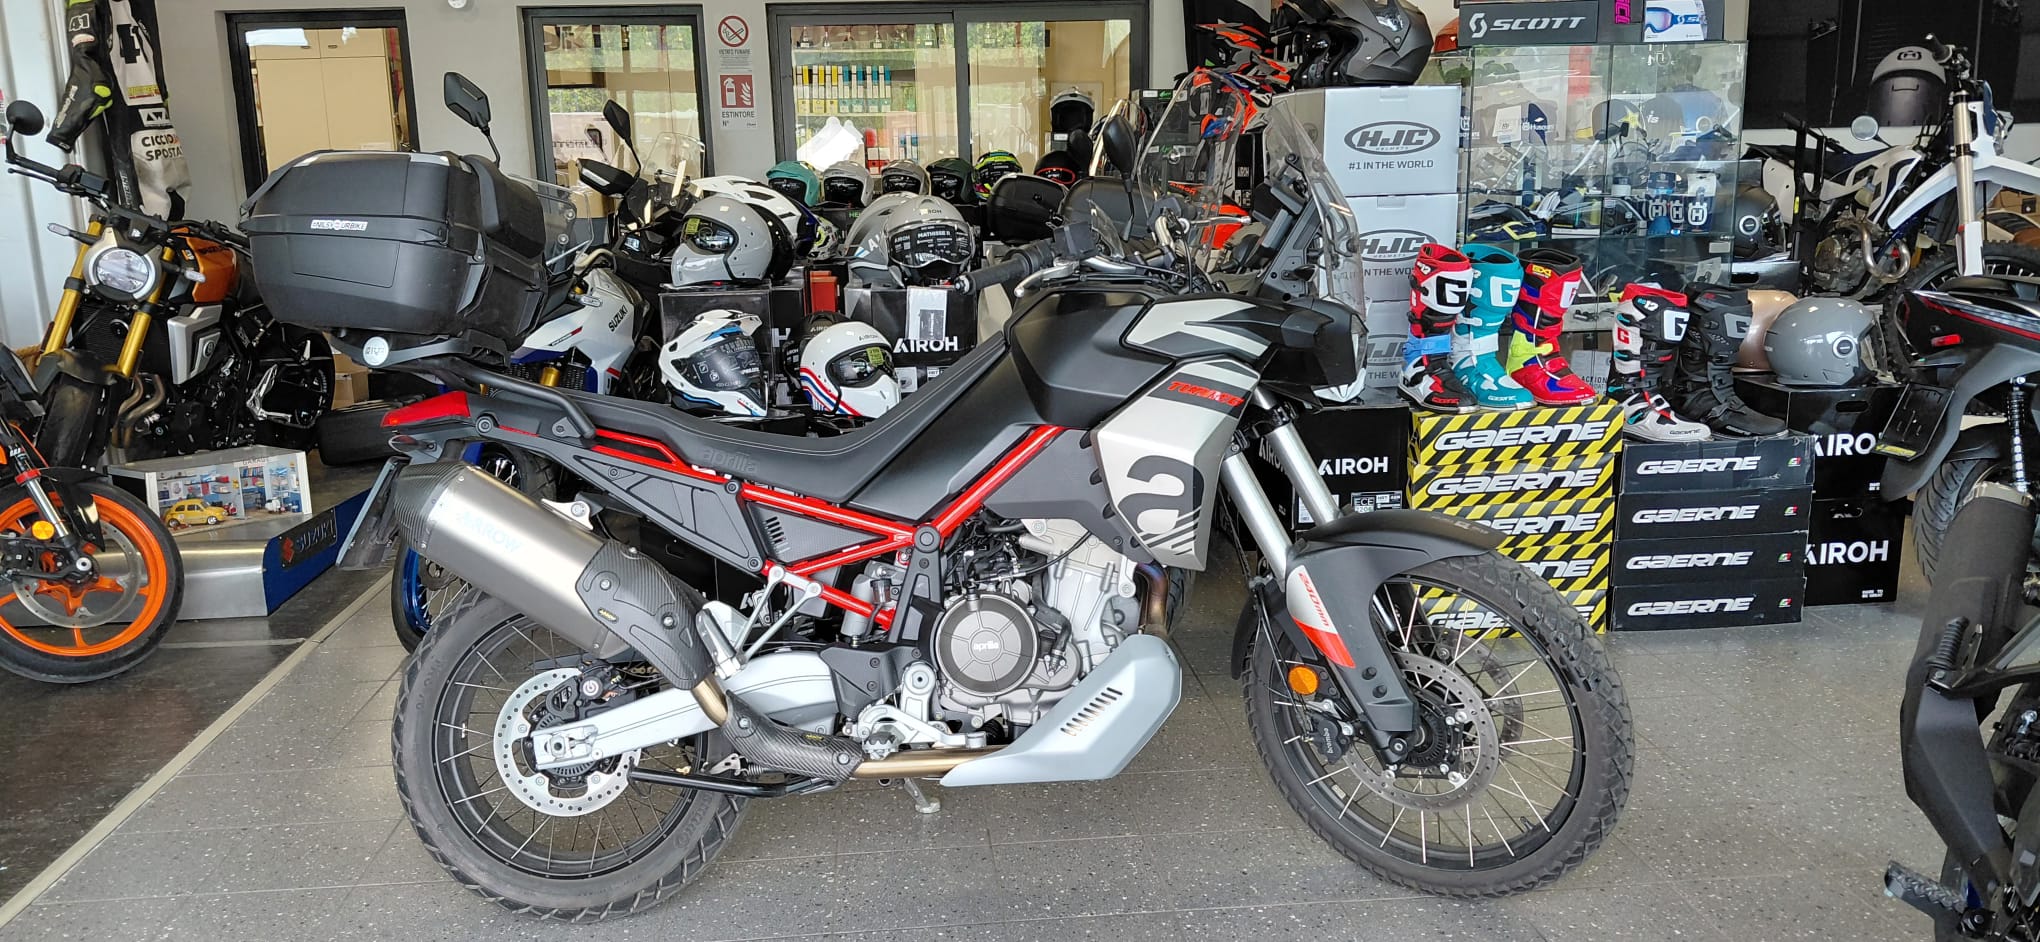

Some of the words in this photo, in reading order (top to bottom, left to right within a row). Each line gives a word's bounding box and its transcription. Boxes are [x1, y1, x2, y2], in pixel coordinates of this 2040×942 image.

[69, 13, 90, 32] 41
[1490, 16, 1586, 31] SCOTT
[721, 110, 755, 118] ESTINTORE
[141, 134, 174, 148] CICCIO
[1356, 129, 1428, 147] HJC
[1348, 161, 1361, 170] #1
[1363, 161, 1373, 169] IN
[1375, 160, 1395, 169] THE
[1396, 160, 1434, 169] WORLD
[1360, 237, 1426, 255] HJC
[1374, 268, 1393, 276] THE
[608, 304, 629, 333] SUZUKI
[893, 336, 959, 354] AIROH
[1813, 432, 1883, 457] AIRO
[1318, 456, 1389, 476] AIROH
[296, 518, 335, 553] SUZUKI
[973, 640, 1000, 653] aprilia
[1322, 727, 1336, 755] brembo
